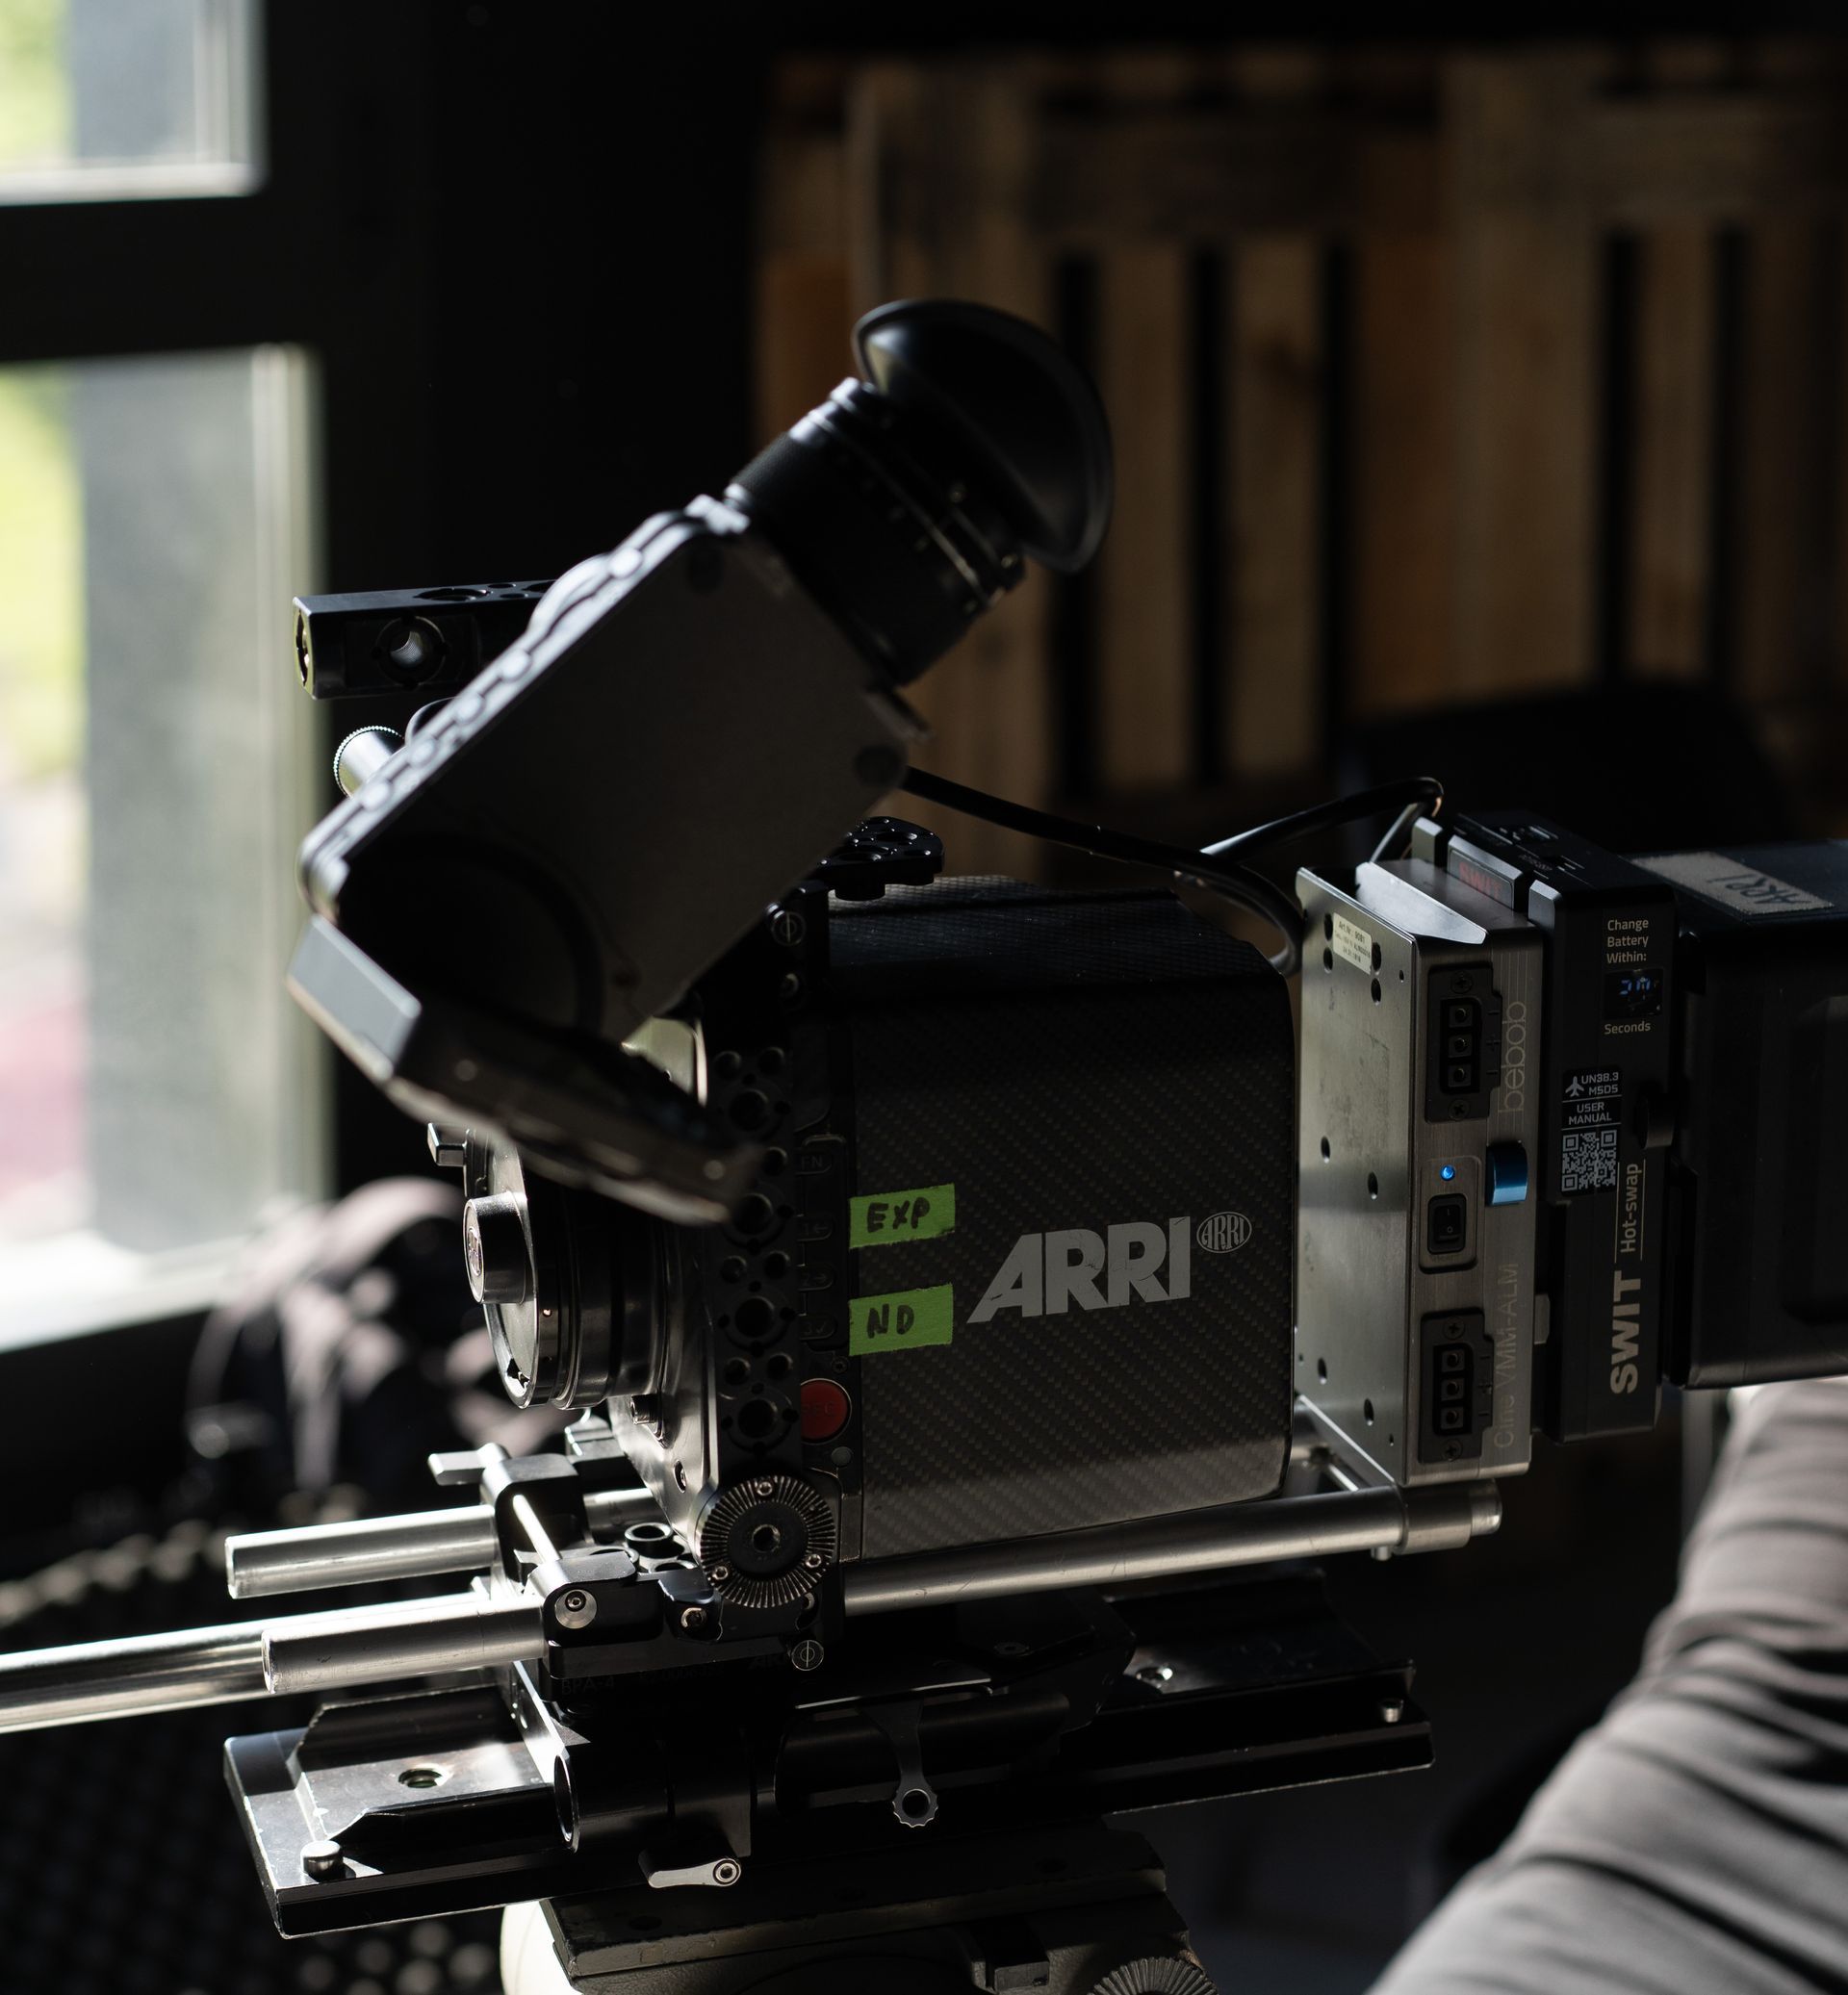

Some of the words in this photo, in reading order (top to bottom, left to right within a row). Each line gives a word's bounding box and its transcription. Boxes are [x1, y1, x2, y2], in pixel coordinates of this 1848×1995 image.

[1606, 918, 1650, 933] Change
[1606, 935, 1650, 949] Battery
[1605, 950, 1648, 965] Within:
[1604, 1020, 1652, 1036] Seconds
[1498, 1001, 1527, 1113] bebob
[1580, 1071, 1620, 1086] UN38.3
[1588, 1085, 1619, 1097] MSDS
[1568, 1112, 1613, 1126] MANUAL
[1576, 1101, 1605, 1114] USER
[866, 1196, 932, 1235] EXP
[1620, 1163, 1643, 1254] Hot-swap
[1198, 1213, 1250, 1252] ARRI
[966, 1215, 1192, 1324] ARRI
[866, 1304, 915, 1339] ND
[1494, 1263, 1519, 1389] VMM-ALM
[1609, 1269, 1642, 1395] SWIT
[1493, 1394, 1516, 1449] Cine
